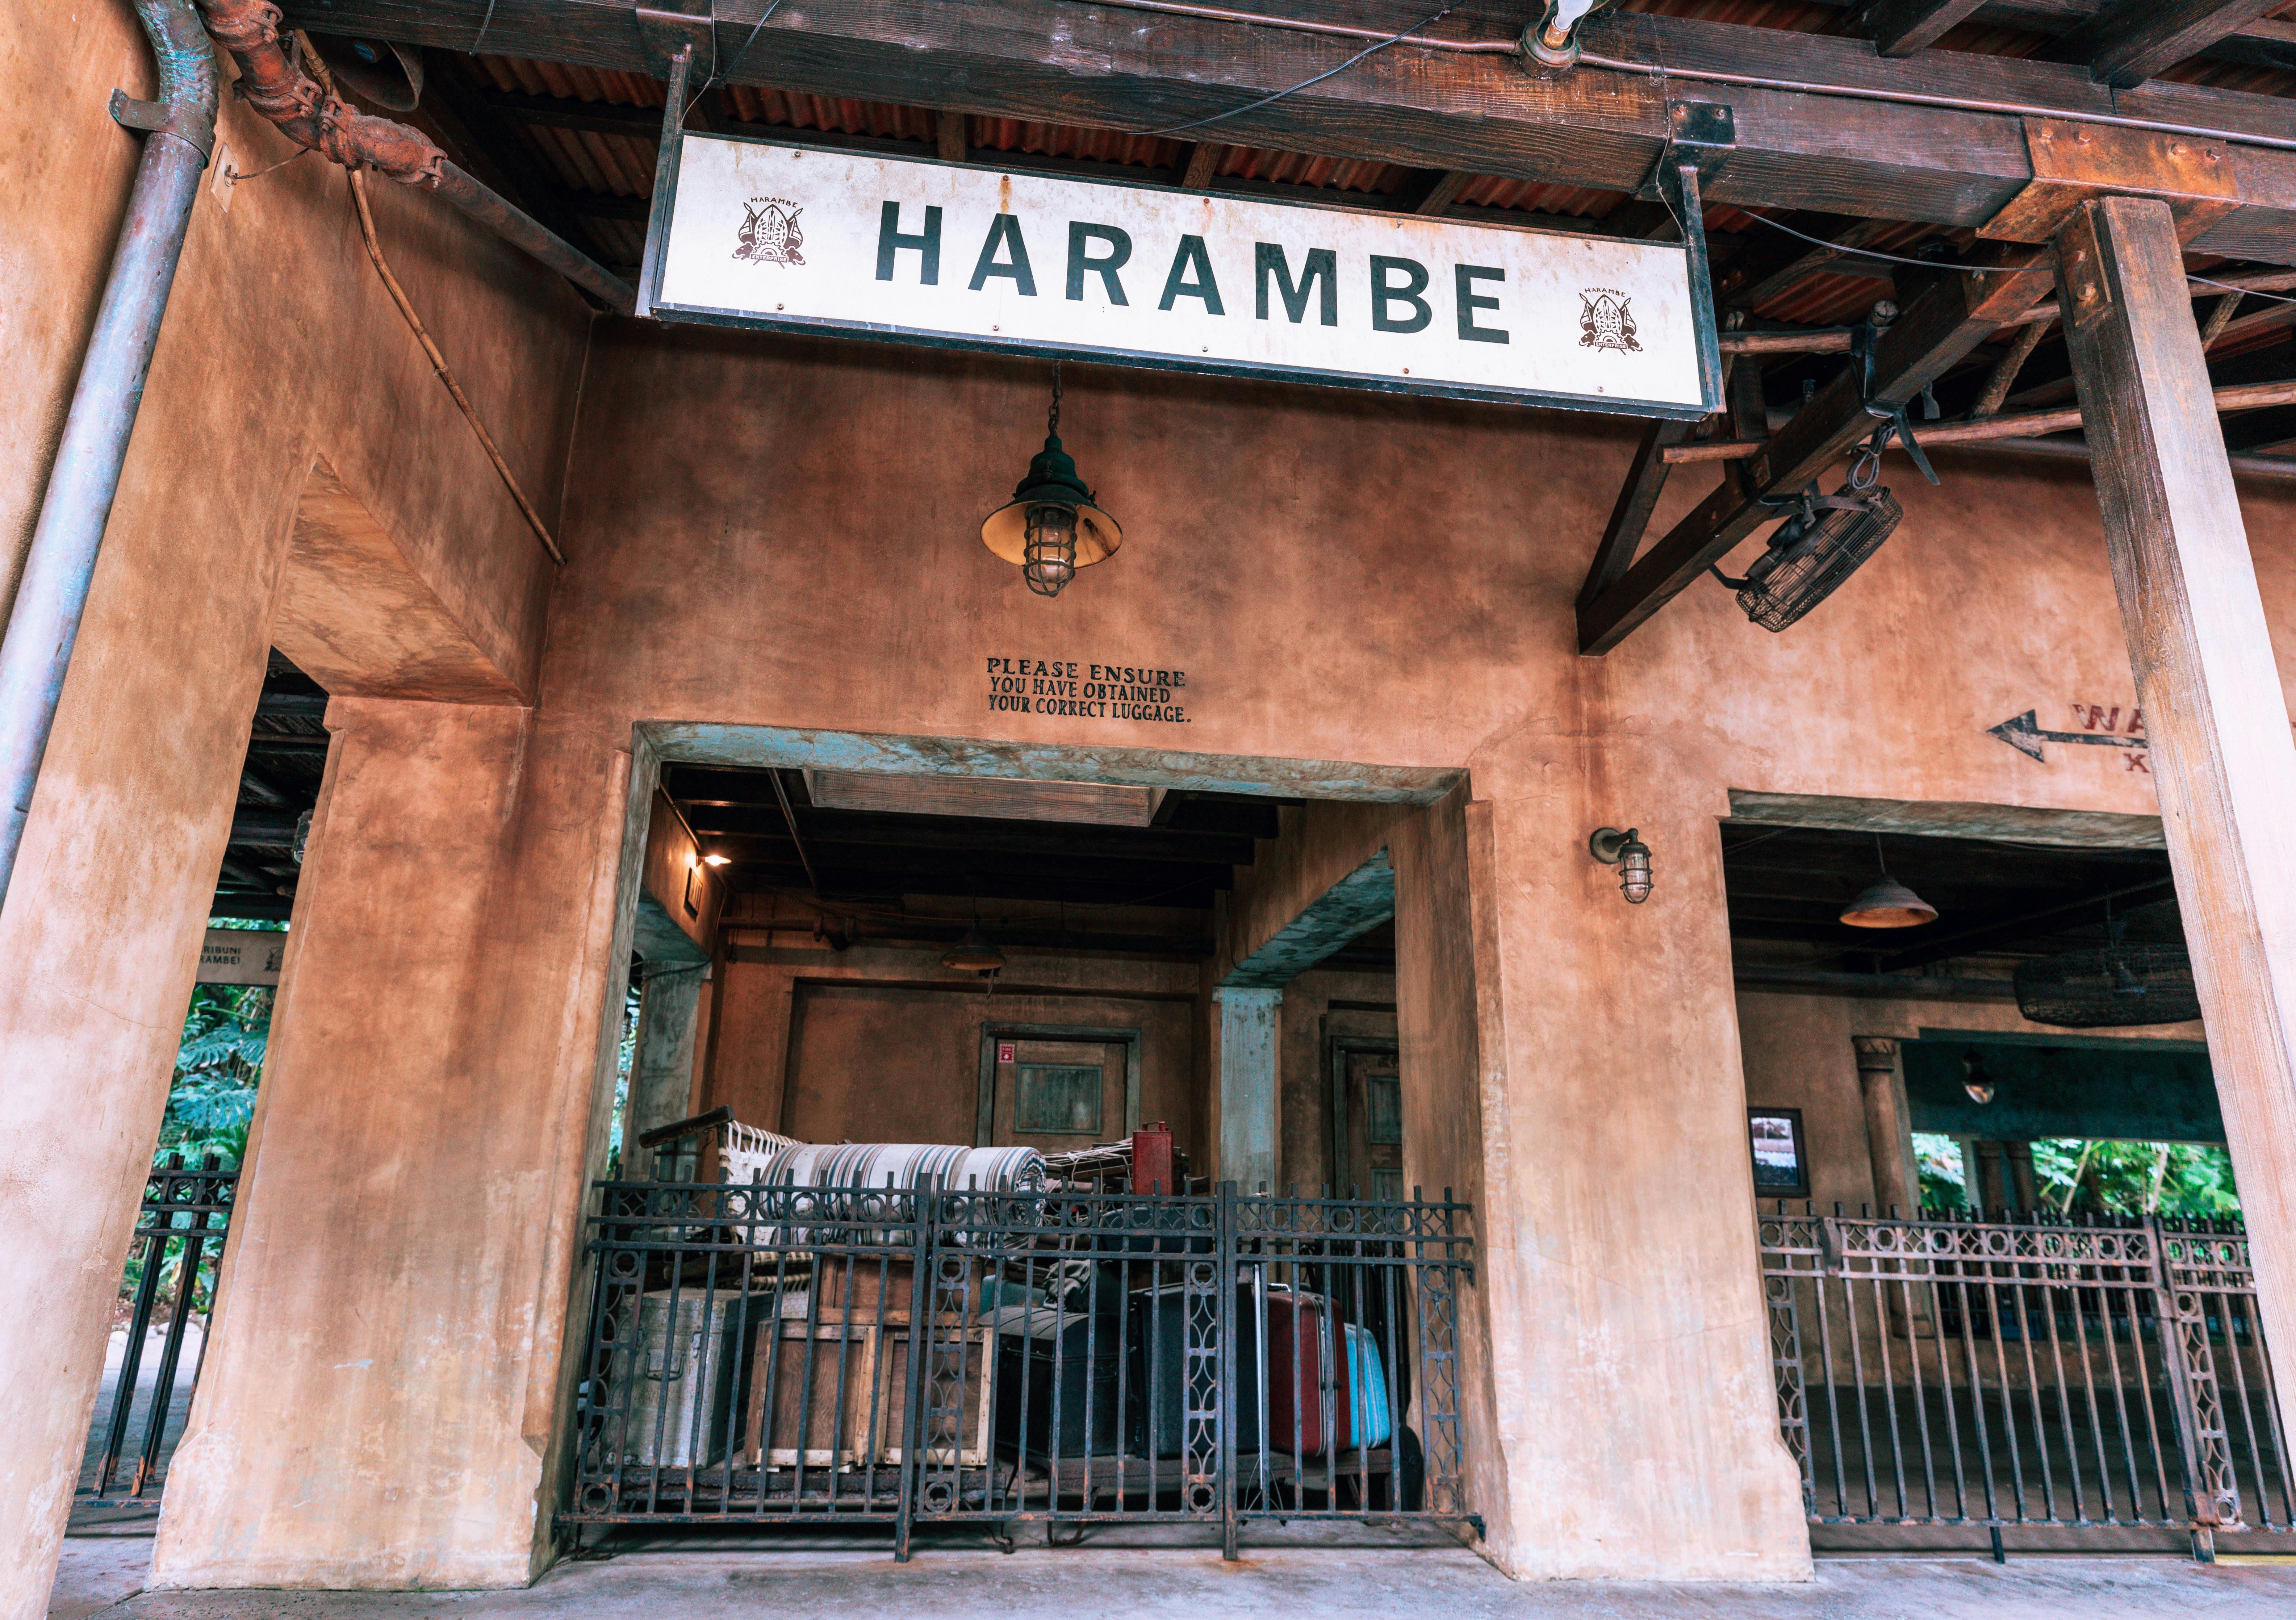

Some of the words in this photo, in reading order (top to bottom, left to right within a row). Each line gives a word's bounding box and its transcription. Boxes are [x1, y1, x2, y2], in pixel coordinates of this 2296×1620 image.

[751, 197, 798, 208] HARAMBE
[875, 200, 1510, 345] HARAMBE
[1584, 287, 1626, 297] HARAMBE
[987, 657, 1079, 679] PLEASE
[1090, 664, 1186, 687] ENSURE
[991, 677, 1026, 694] YOU
[1032, 679, 1077, 698] HAVE
[1083, 682, 1170, 703] OBTAINED
[988, 694, 1031, 713] YOUR
[1036, 698, 1107, 718] CORRECT
[1112, 703, 1192, 723] LUGGAGE.
